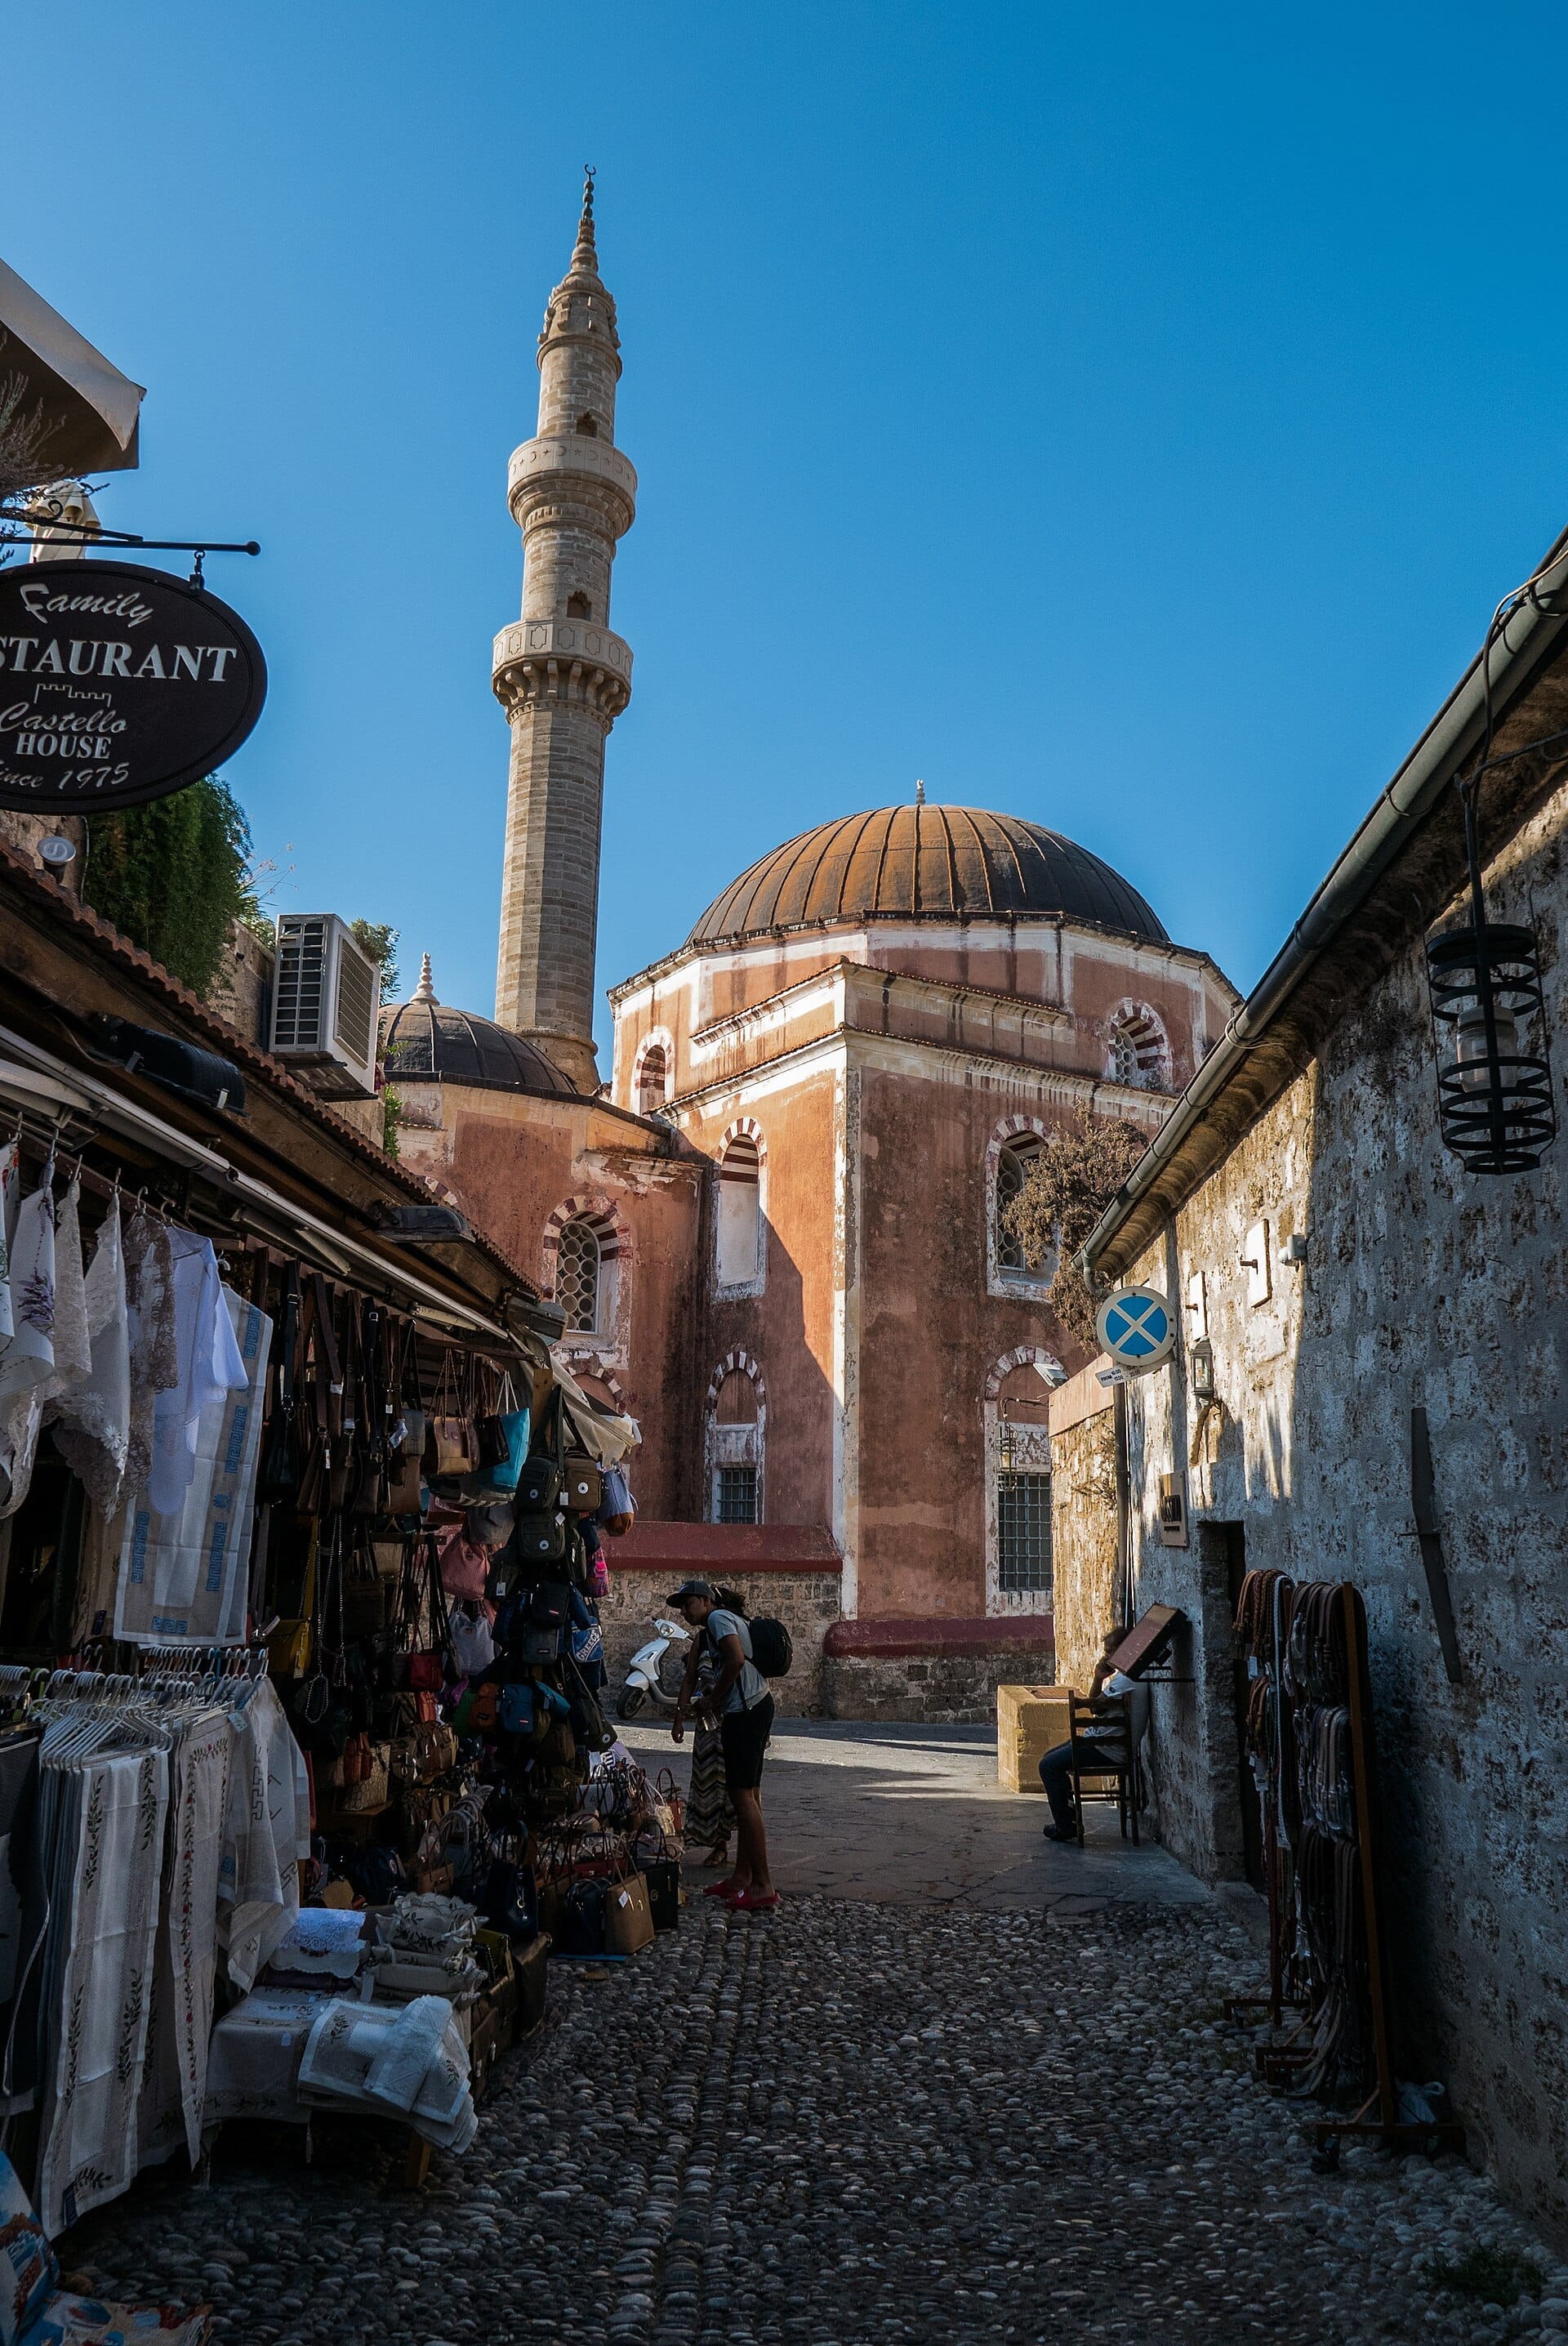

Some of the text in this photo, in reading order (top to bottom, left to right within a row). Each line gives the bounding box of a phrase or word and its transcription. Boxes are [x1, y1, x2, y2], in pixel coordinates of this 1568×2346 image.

[20, 582, 154, 628] Family
[0, 701, 127, 734] Castello
[16, 732, 112, 760] HOUSE
[0, 760, 130, 790] ince 1975
[576, 1629, 600, 1661] GREECE
